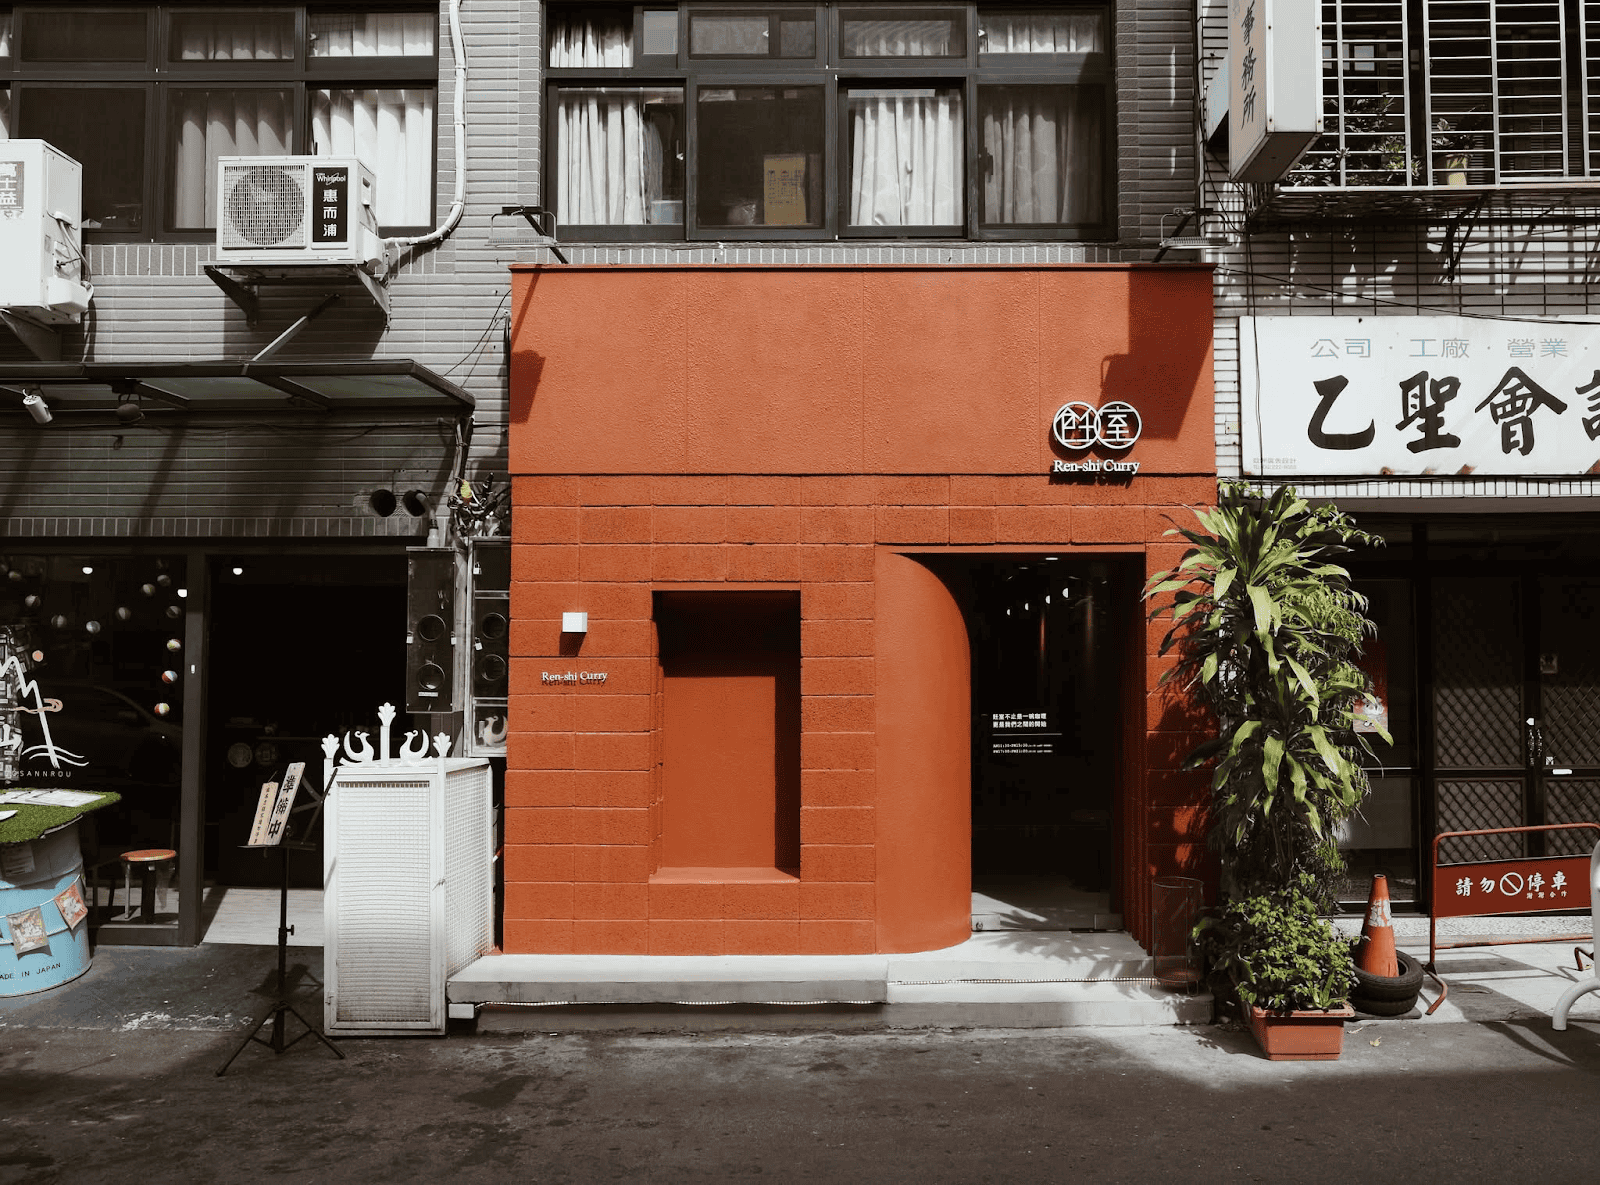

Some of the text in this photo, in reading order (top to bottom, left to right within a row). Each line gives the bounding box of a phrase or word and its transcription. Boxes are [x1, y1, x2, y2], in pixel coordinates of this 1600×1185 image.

[323, 189, 338, 237] 惠而浦
[1310, 338, 1568, 359] 公司 工廠 營業
[1053, 459, 1140, 474] Ren-shi Curry
[542, 671, 607, 682] Ren-shi Curry
[21, 970, 30, 978] IN
[36, 962, 61, 975] JAPAN
